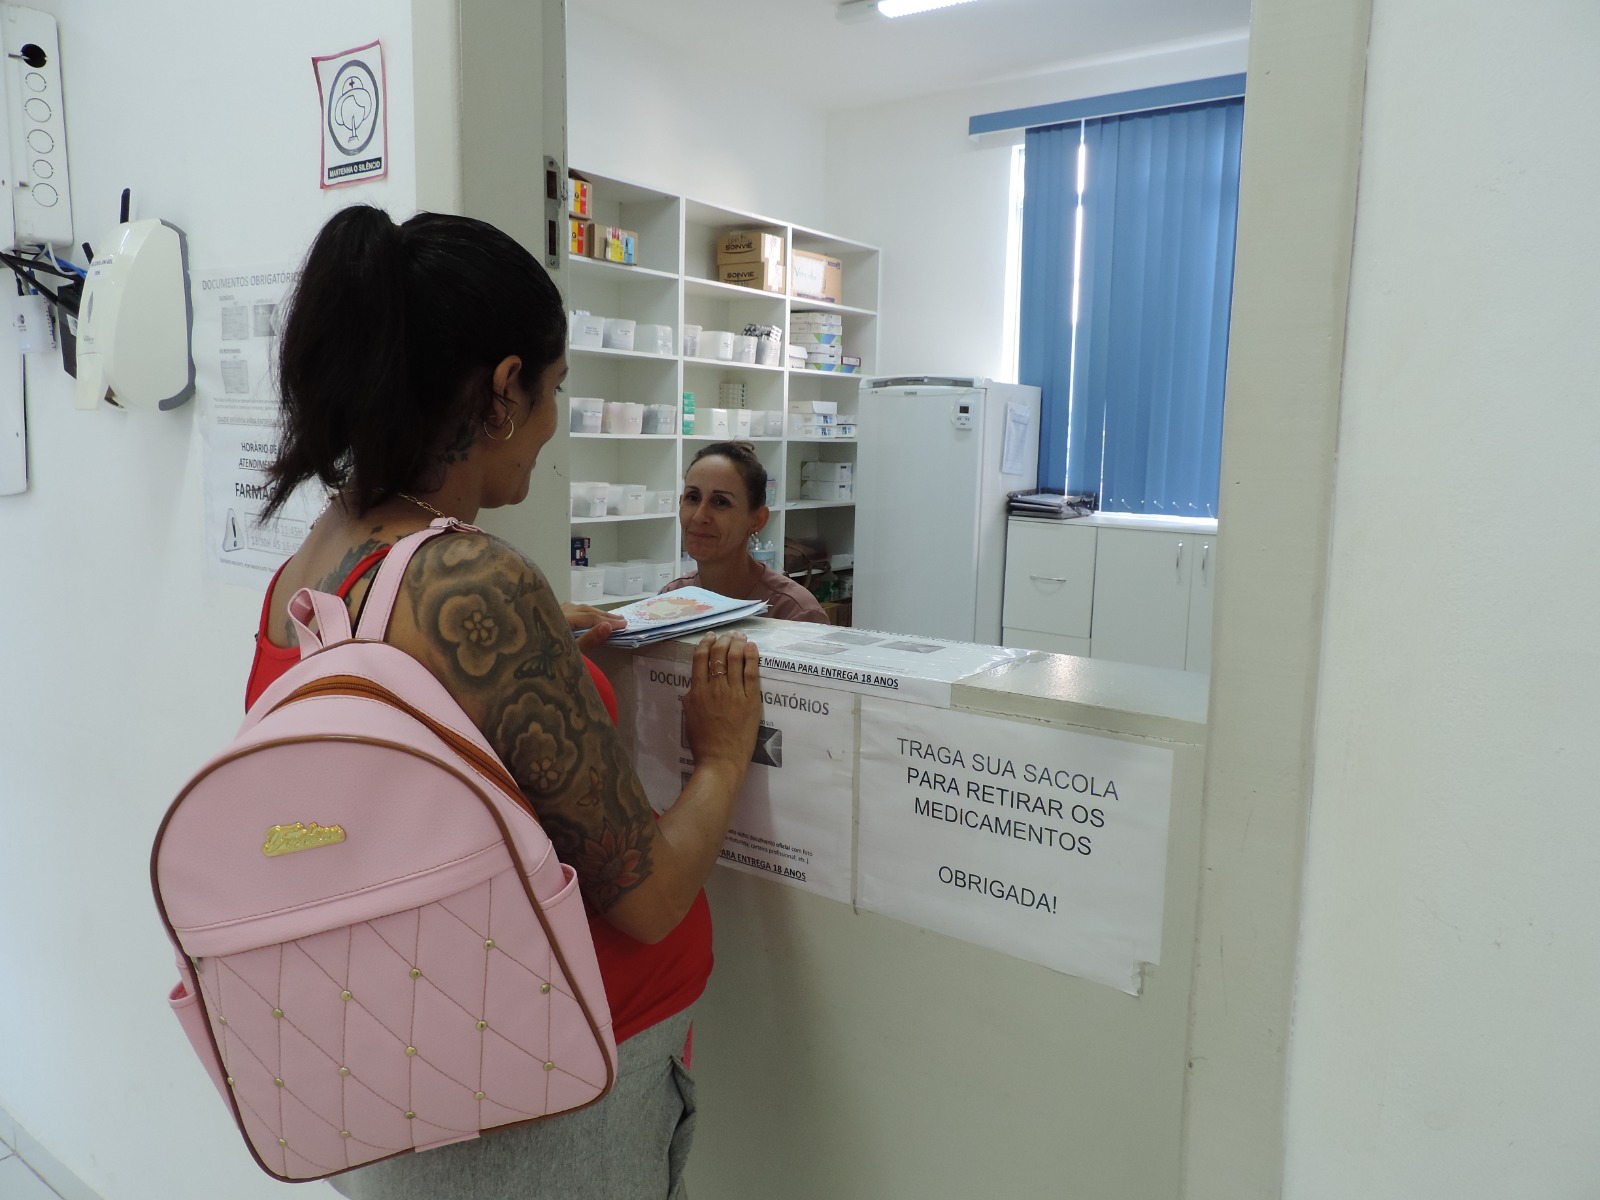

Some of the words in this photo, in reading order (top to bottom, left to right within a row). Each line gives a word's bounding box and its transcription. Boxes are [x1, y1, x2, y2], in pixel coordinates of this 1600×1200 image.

[329, 166, 353, 178] MANTENHA
[353, 165, 358, 173] O
[358, 160, 381, 172] SILÊNCIO
[571, 231, 577, 239] G
[202, 276, 249, 290] DOCUMENTOS
[250, 270, 301, 287] OBRIGATÓRIO
[241, 441, 268, 454] HORÁRIO
[235, 482, 276, 501] FARMAC
[764, 656, 796, 671] MÍNIMA
[798, 663, 819, 675] PARA
[821, 667, 859, 682] ENTREGA
[861, 673, 872, 683] 18
[873, 676, 899, 688] ANOS
[650, 669, 692, 689] DOCUM
[760, 691, 830, 716] IGATÓRIOS
[897, 737, 966, 768] TRAGA
[972, 753, 1016, 779] SUA
[1023, 763, 1119, 801] SACOLA
[907, 767, 960, 796] PARA
[967, 781, 1064, 819] RETIRAR
[1071, 804, 1105, 828] OS
[915, 797, 1092, 856] MEDICAMENTOS
[749, 833, 776, 847] documento
[776, 841, 791, 852] oficial
[802, 848, 814, 857] foto
[720, 849, 737, 861] ARA
[737, 853, 772, 871] ENTREGA
[773, 863, 783, 874] 18
[783, 867, 807, 880] ANOS
[938, 866, 1057, 914] OBRIGADA!
